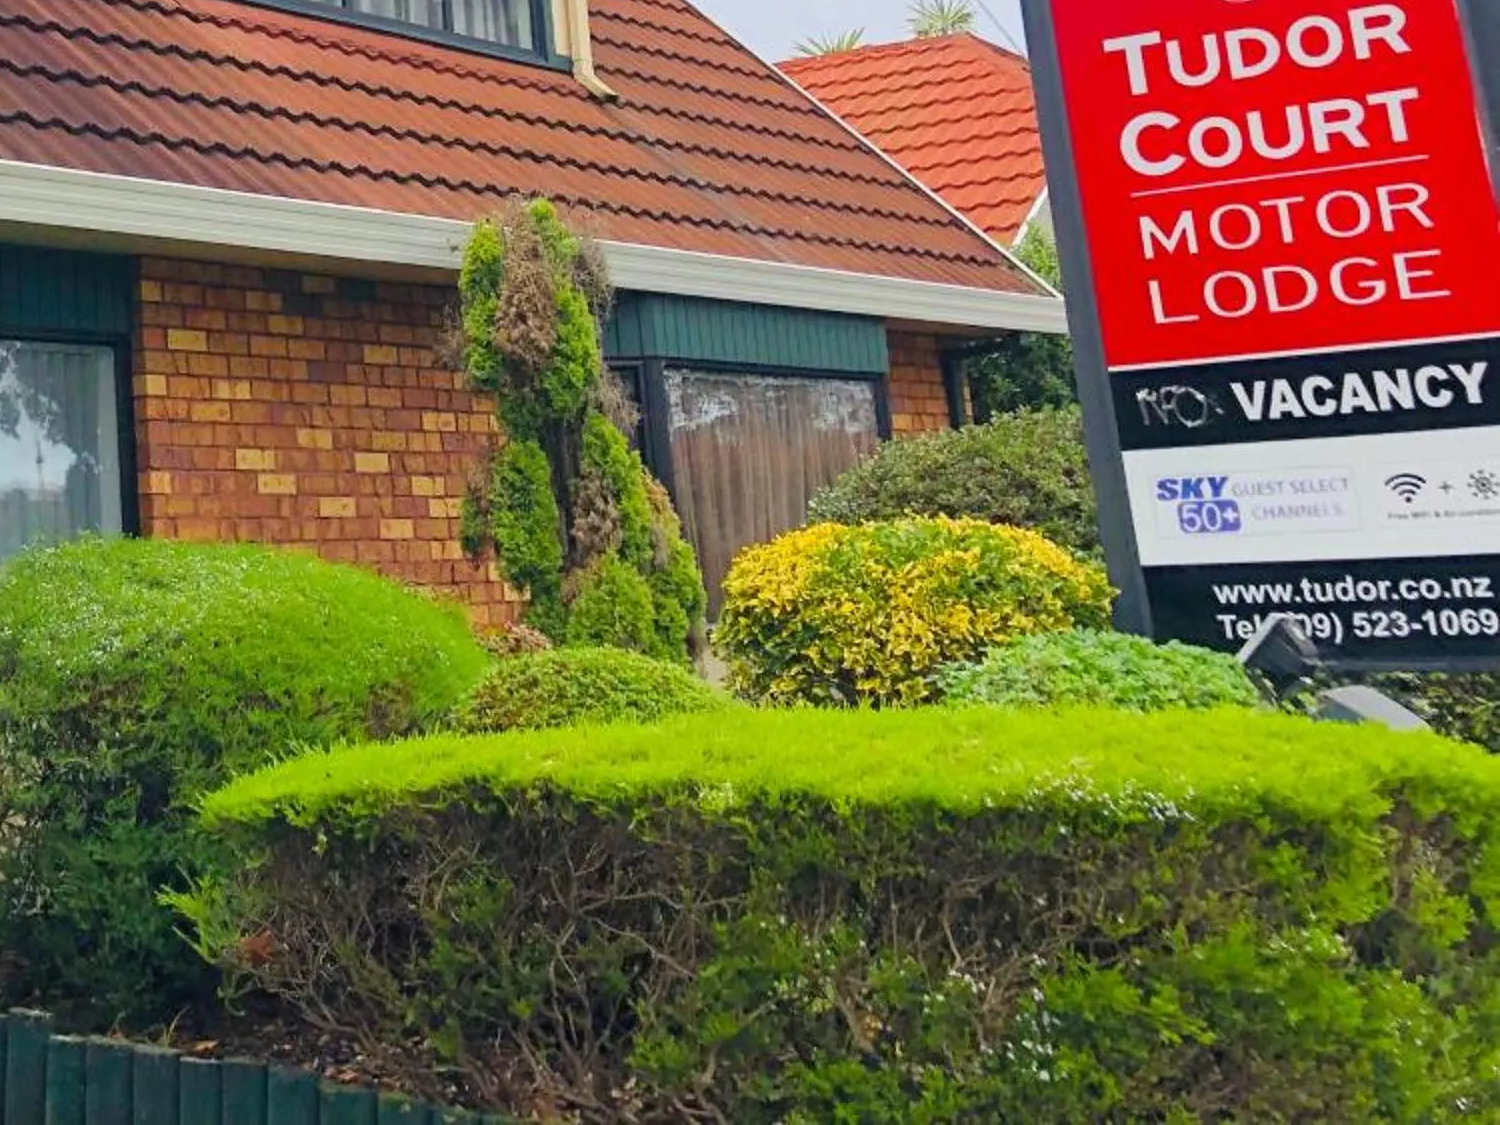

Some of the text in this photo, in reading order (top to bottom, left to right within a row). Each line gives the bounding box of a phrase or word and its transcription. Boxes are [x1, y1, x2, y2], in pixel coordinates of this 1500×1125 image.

[1103, 3, 1411, 96] TUDOR
[1120, 87, 1419, 176] COURT
[1138, 182, 1435, 261] MOTOR
[1148, 249, 1452, 325] LODGE
[1230, 361, 1489, 423] VACANCY
[1156, 475, 1349, 501] SKY GUEST SELECT
[1181, 502, 1344, 532] 50+ CHANNELS
[1212, 575, 1494, 604] www.tudor.co.nz
[1352, 608, 1499, 638] 523-1069
